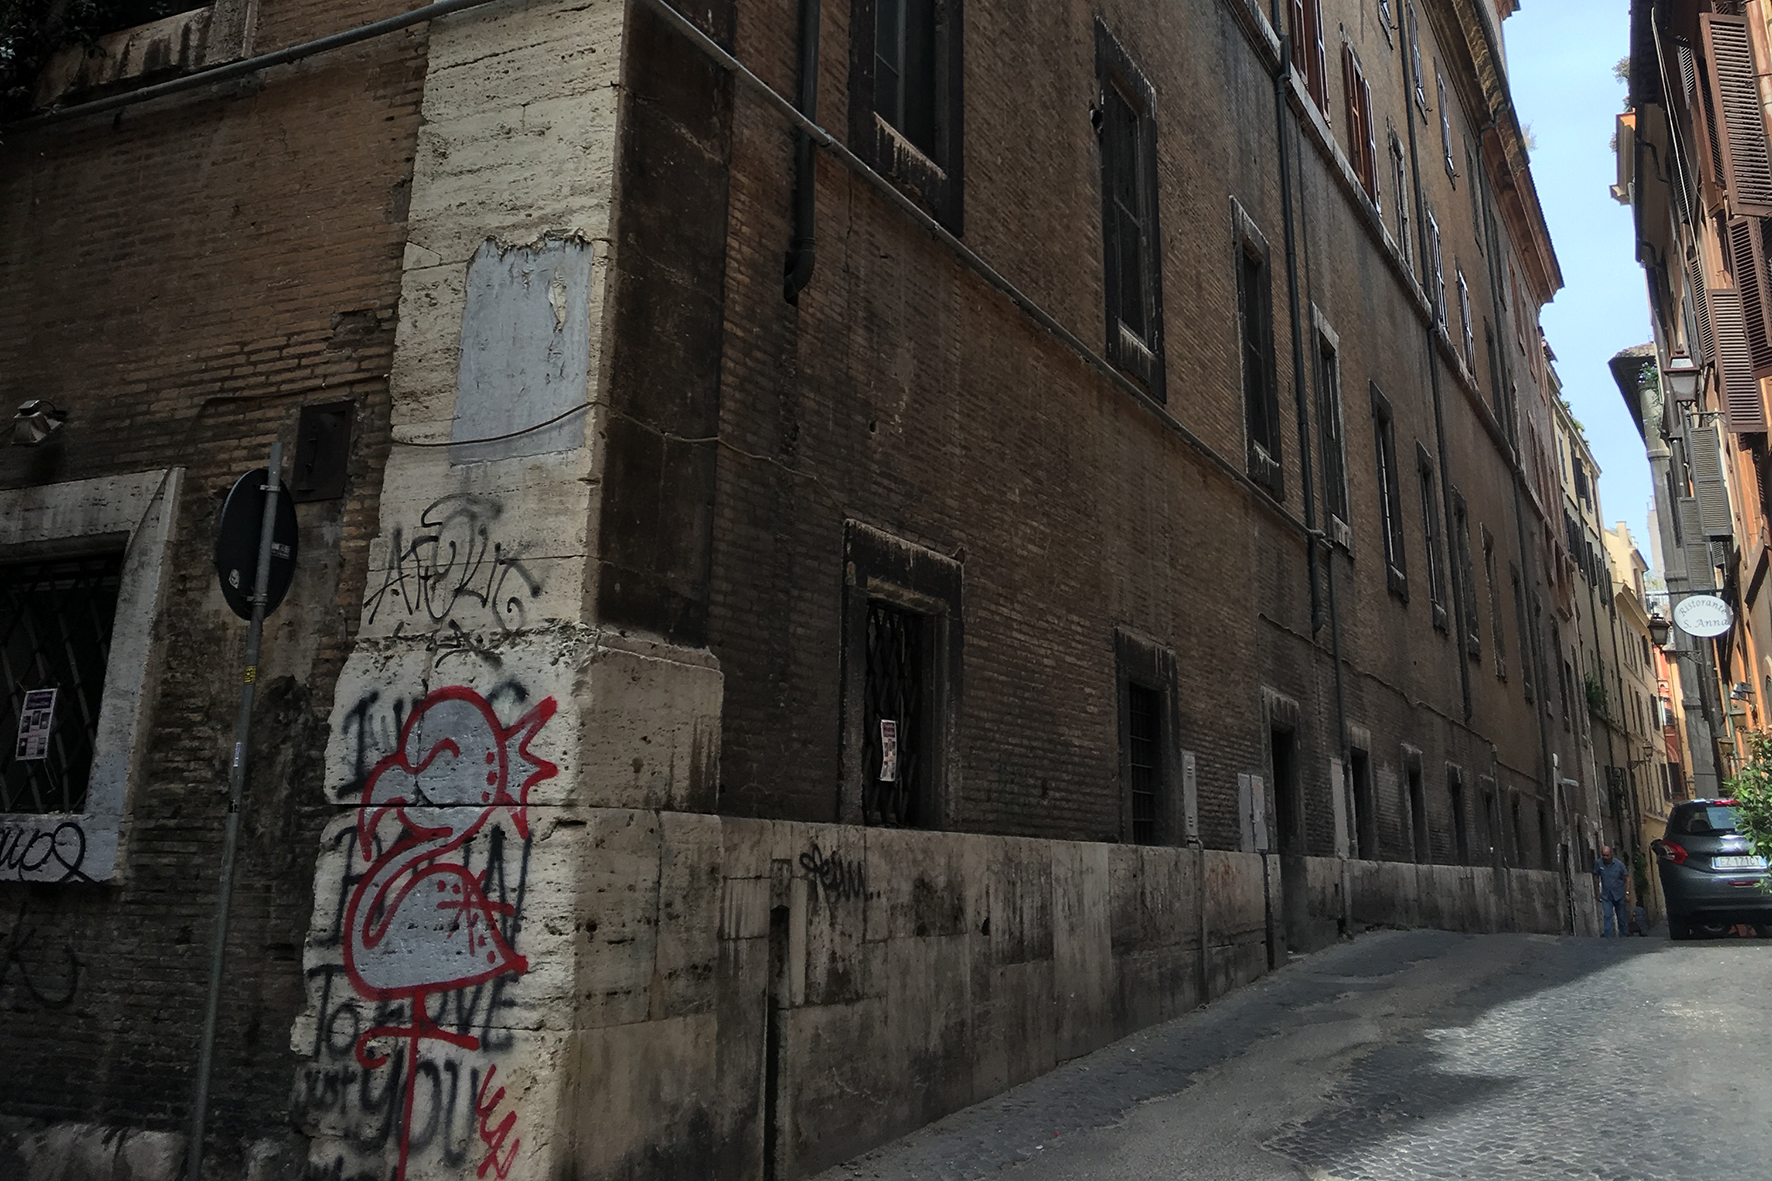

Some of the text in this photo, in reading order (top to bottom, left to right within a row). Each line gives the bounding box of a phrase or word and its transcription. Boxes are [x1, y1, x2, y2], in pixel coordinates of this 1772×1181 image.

[1680, 599, 1729, 617] Ristorante
[1683, 619, 1730, 629] S. Anna
